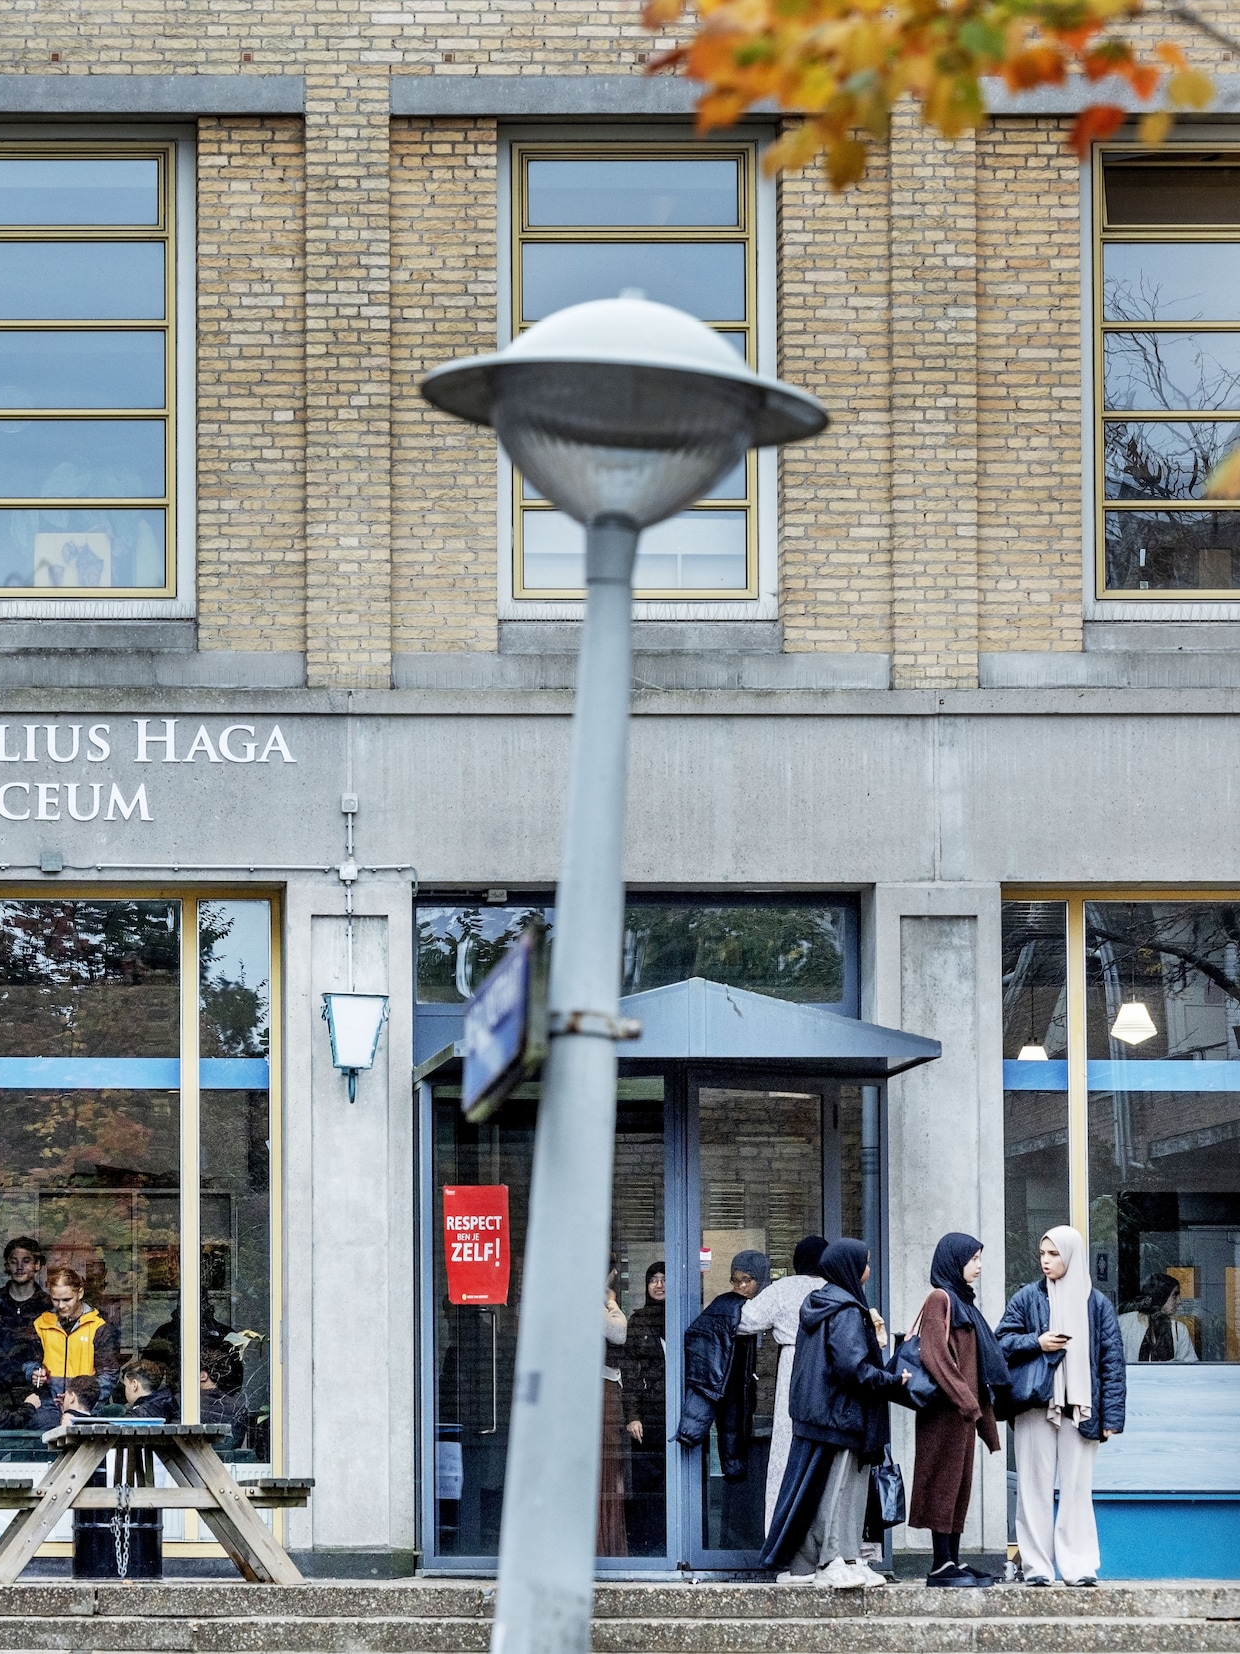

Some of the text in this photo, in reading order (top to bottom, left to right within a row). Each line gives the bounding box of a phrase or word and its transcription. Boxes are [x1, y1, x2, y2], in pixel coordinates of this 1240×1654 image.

[133, 718, 298, 763] HAGA
[446, 1216, 502, 1230] RESPECT
[457, 1233, 480, 1241] BEN JE
[451, 1238, 500, 1267] ZELF!
